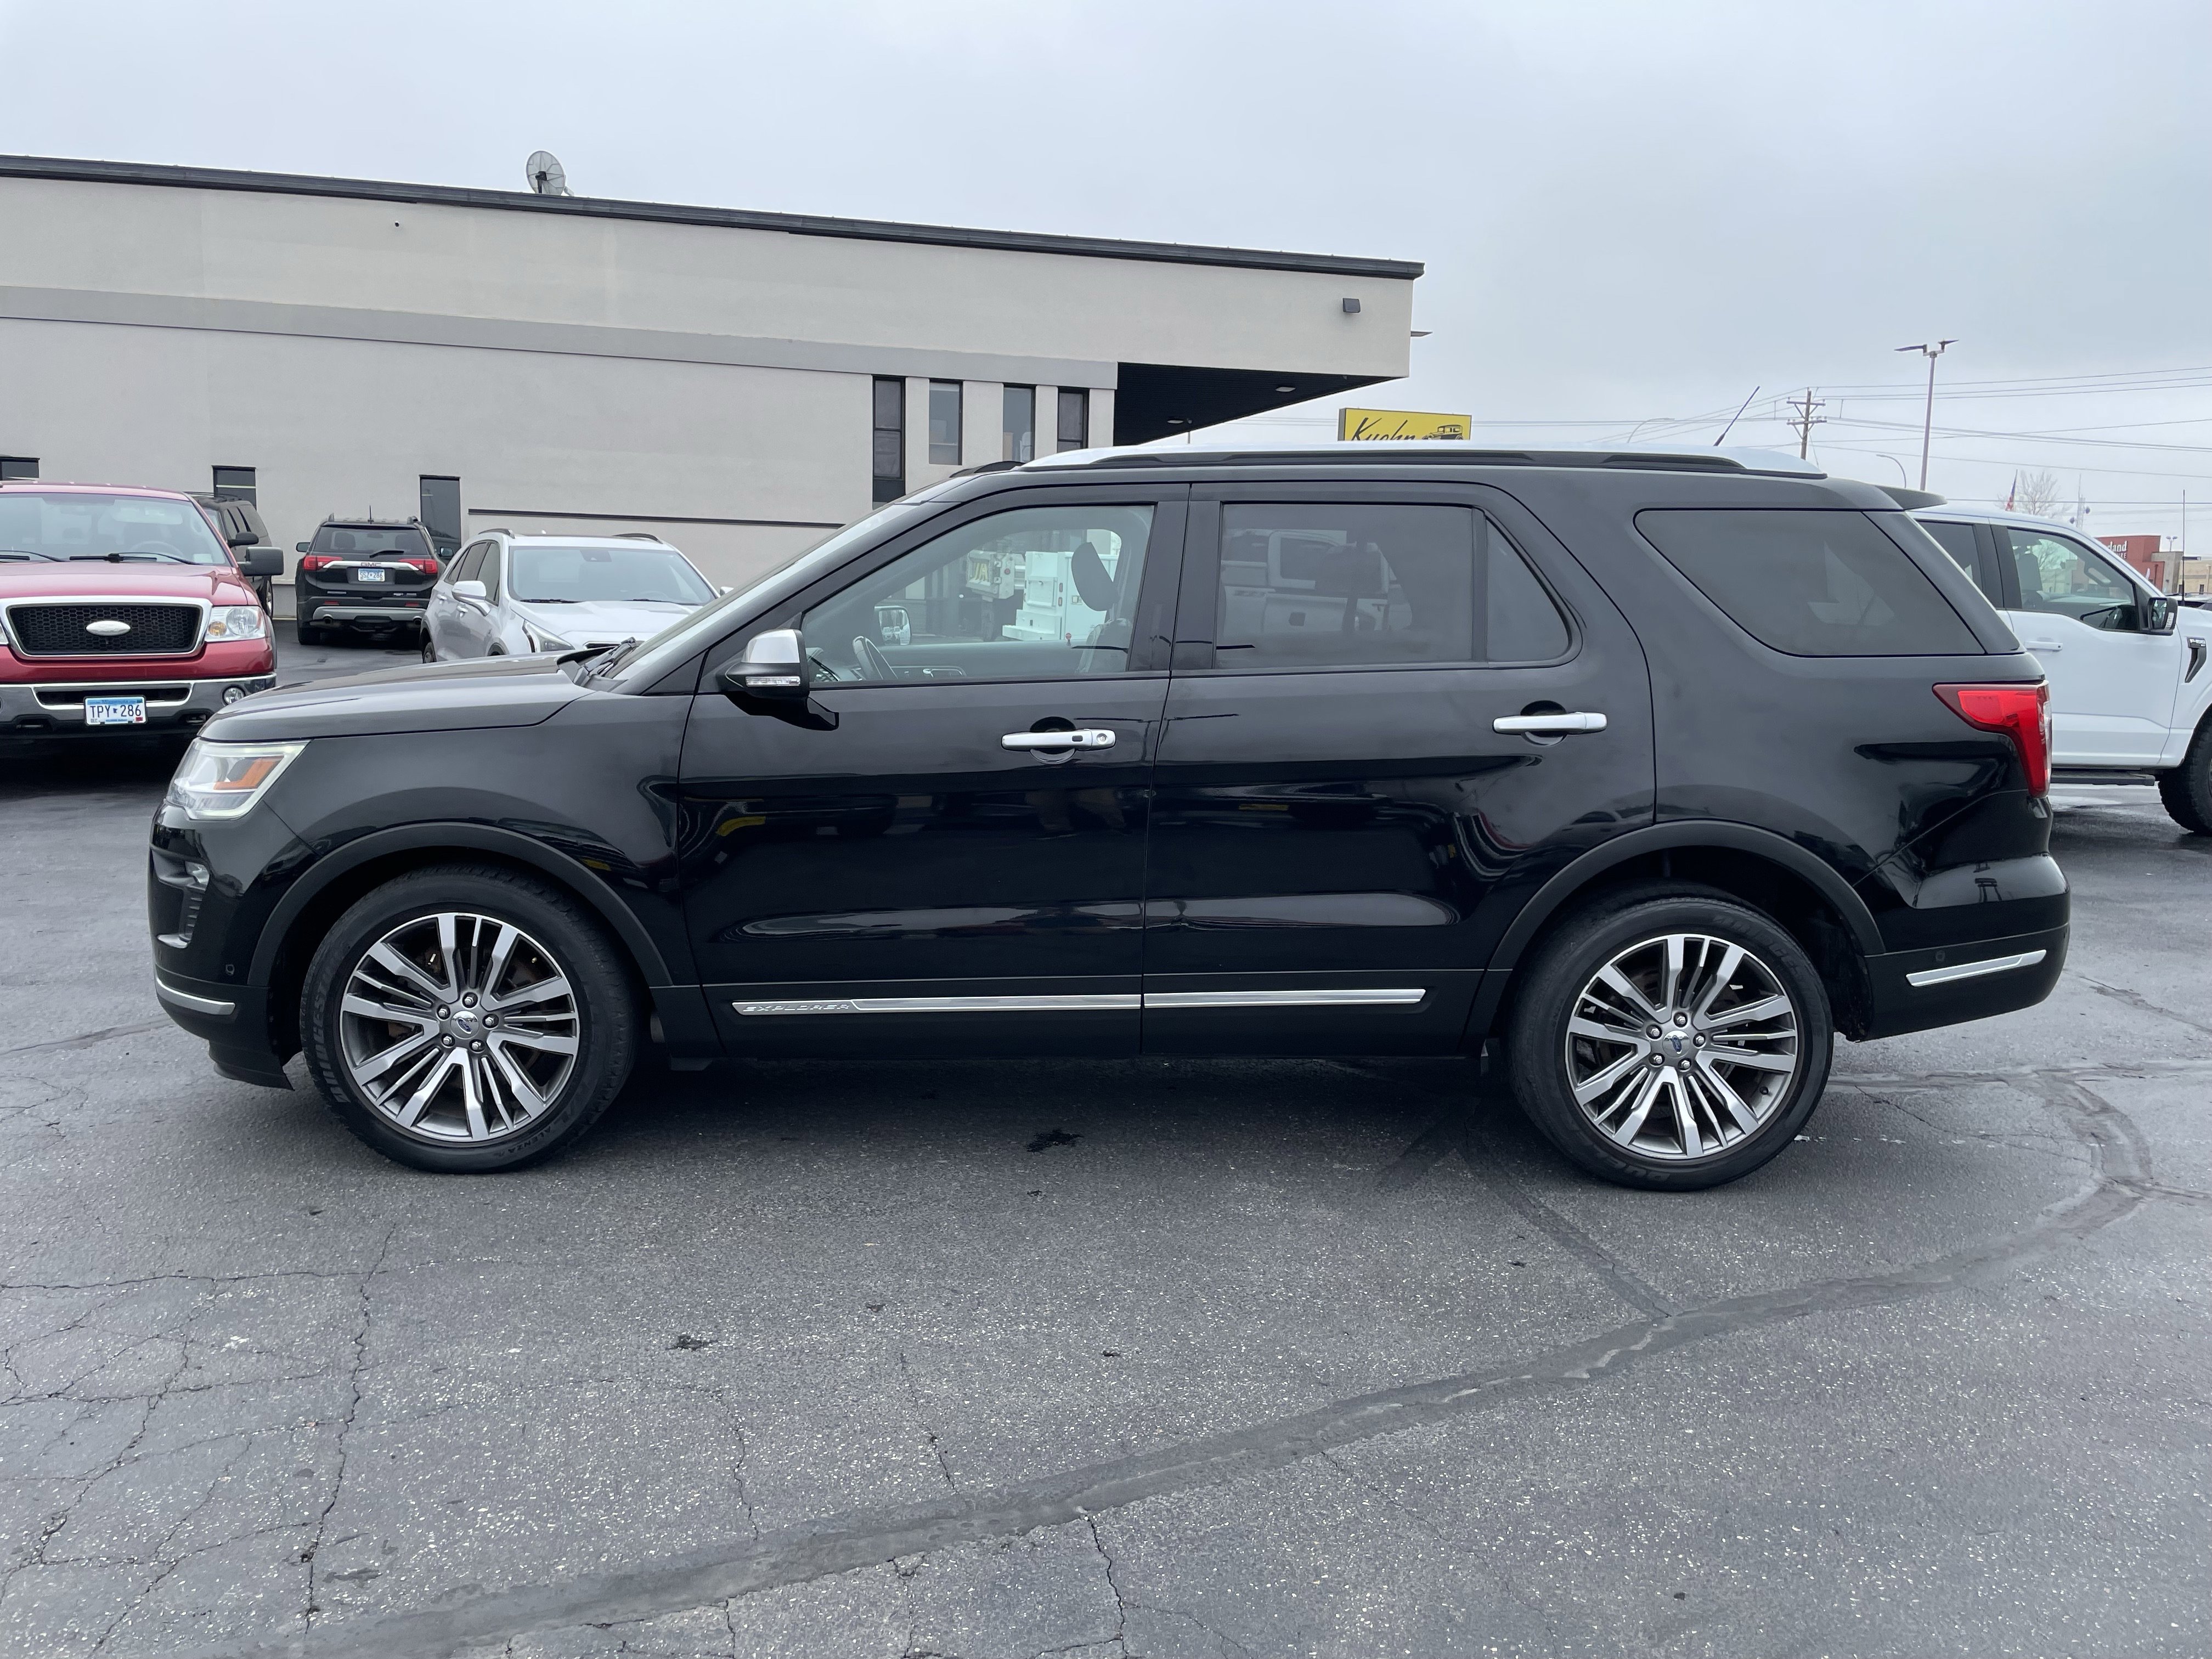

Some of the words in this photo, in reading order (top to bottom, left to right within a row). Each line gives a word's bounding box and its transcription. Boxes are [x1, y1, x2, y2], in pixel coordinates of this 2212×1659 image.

[90, 705, 110, 718] TPY
[120, 704, 142, 717] 286
[743, 1004, 849, 1012] EXPLORER
